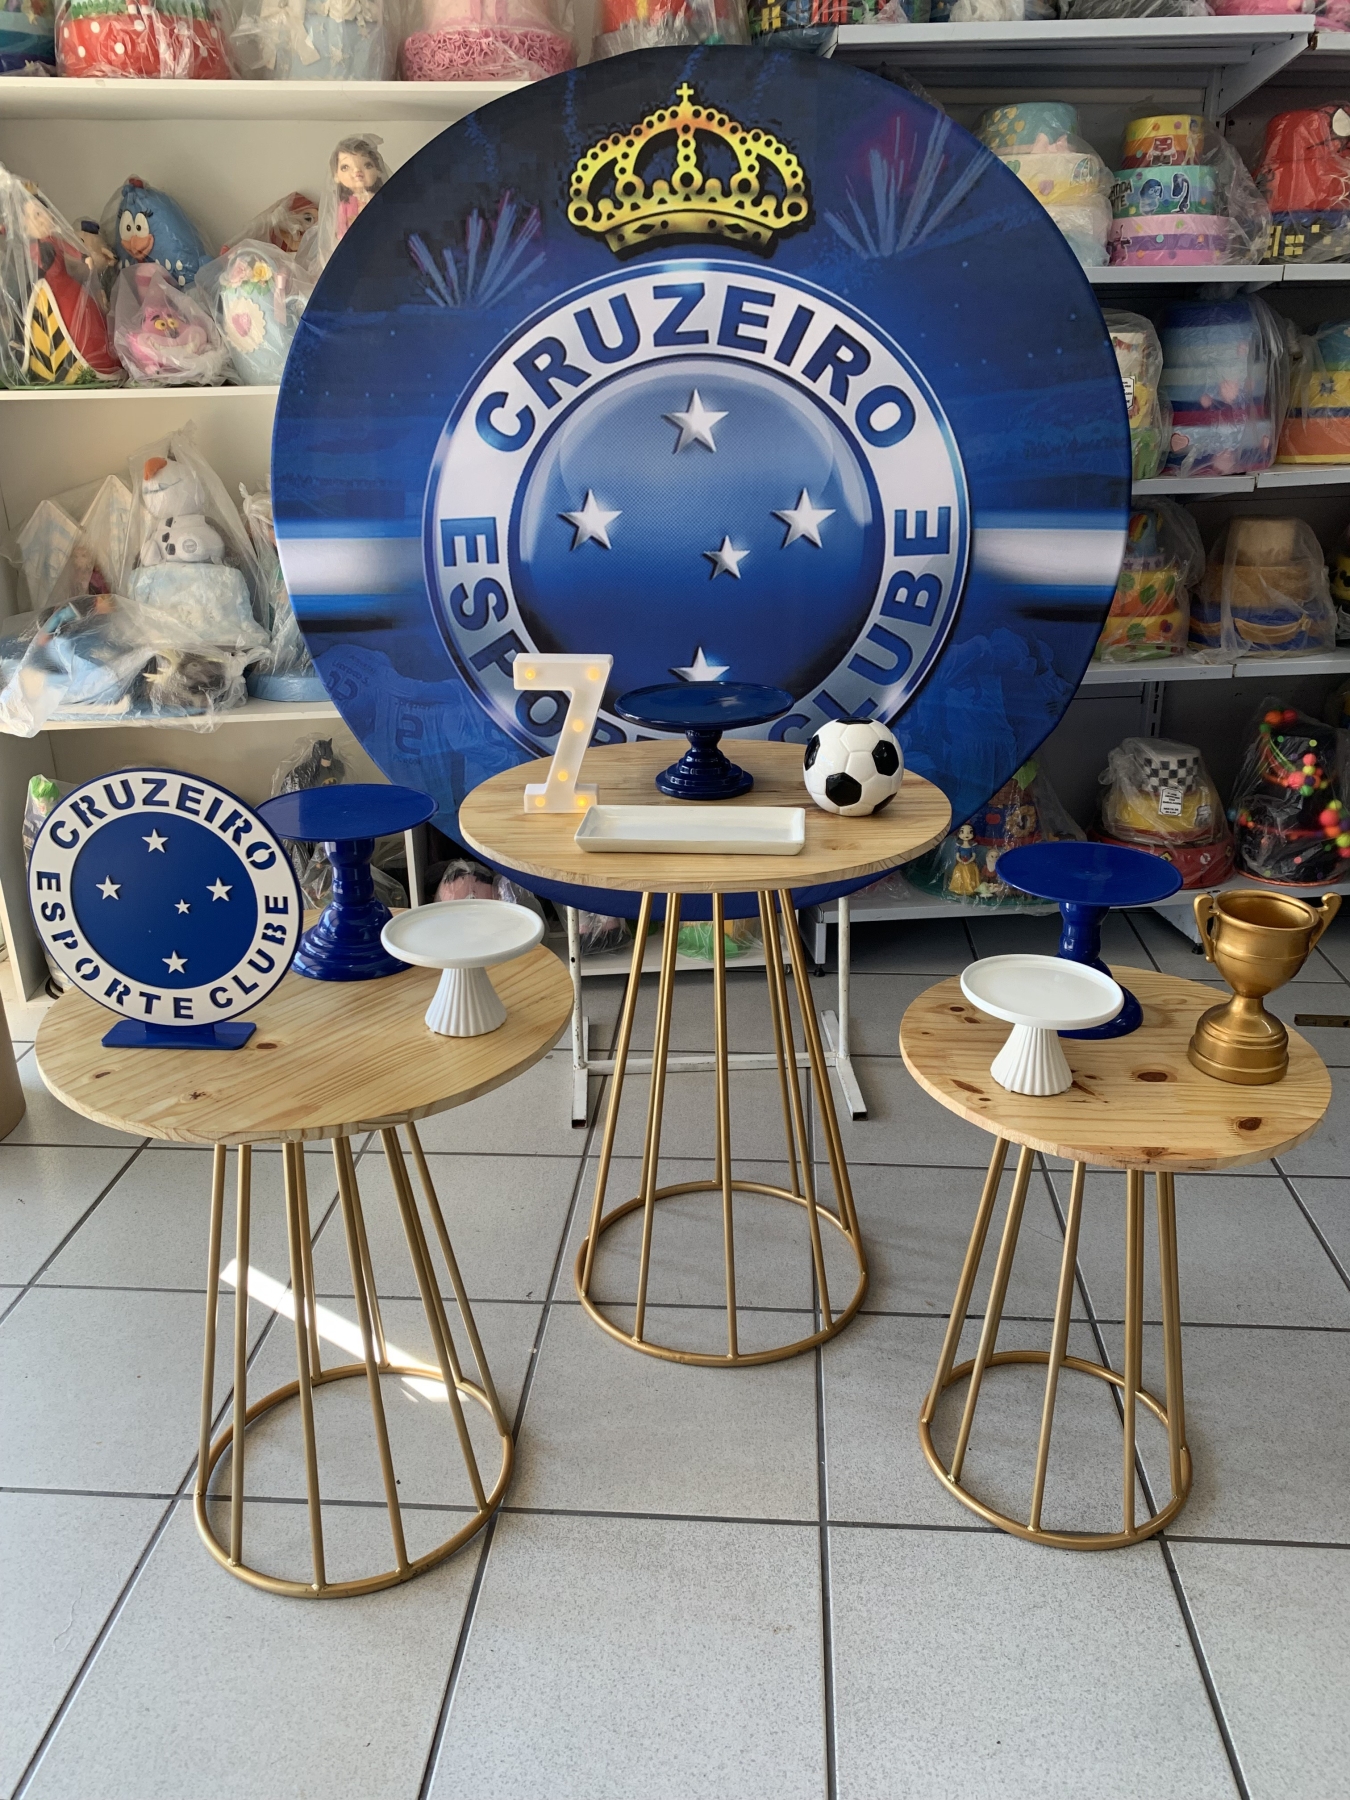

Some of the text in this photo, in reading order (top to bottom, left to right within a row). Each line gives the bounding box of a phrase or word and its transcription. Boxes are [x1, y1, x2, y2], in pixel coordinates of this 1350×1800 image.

[475, 281, 917, 453] CRUZEIRO
[513, 653, 614, 814] 7
[48, 777, 278, 872] CRUZEIRO
[36, 870, 194, 1020] ESPORTE
[209, 894, 289, 1009] CLUBE
